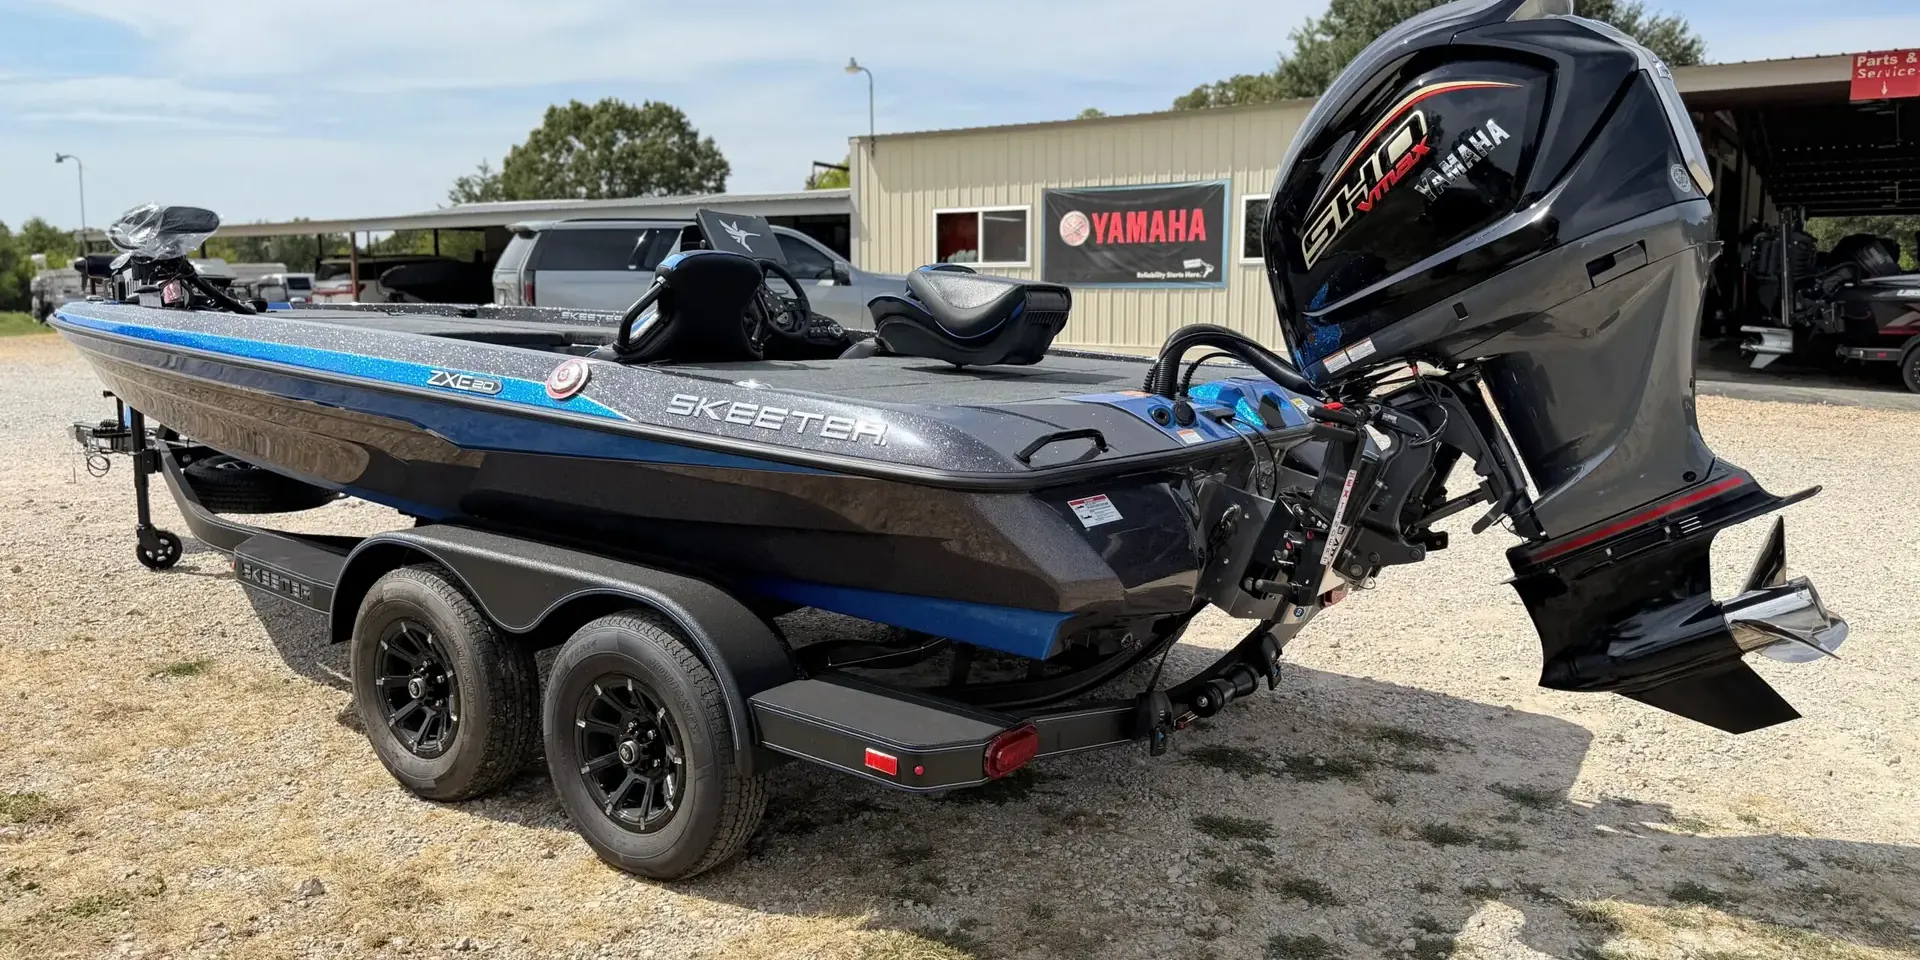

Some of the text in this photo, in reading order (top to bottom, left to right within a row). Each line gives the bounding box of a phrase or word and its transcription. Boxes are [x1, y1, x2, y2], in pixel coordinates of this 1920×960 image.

[1857, 52, 1918, 67] Parts &
[1857, 66, 1916, 79] Service
[1414, 118, 1511, 201] YAMAHA
[1092, 208, 1206, 245] YAMAHA
[666, 393, 888, 447] SKEETER
[241, 563, 312, 602] SKEETER
